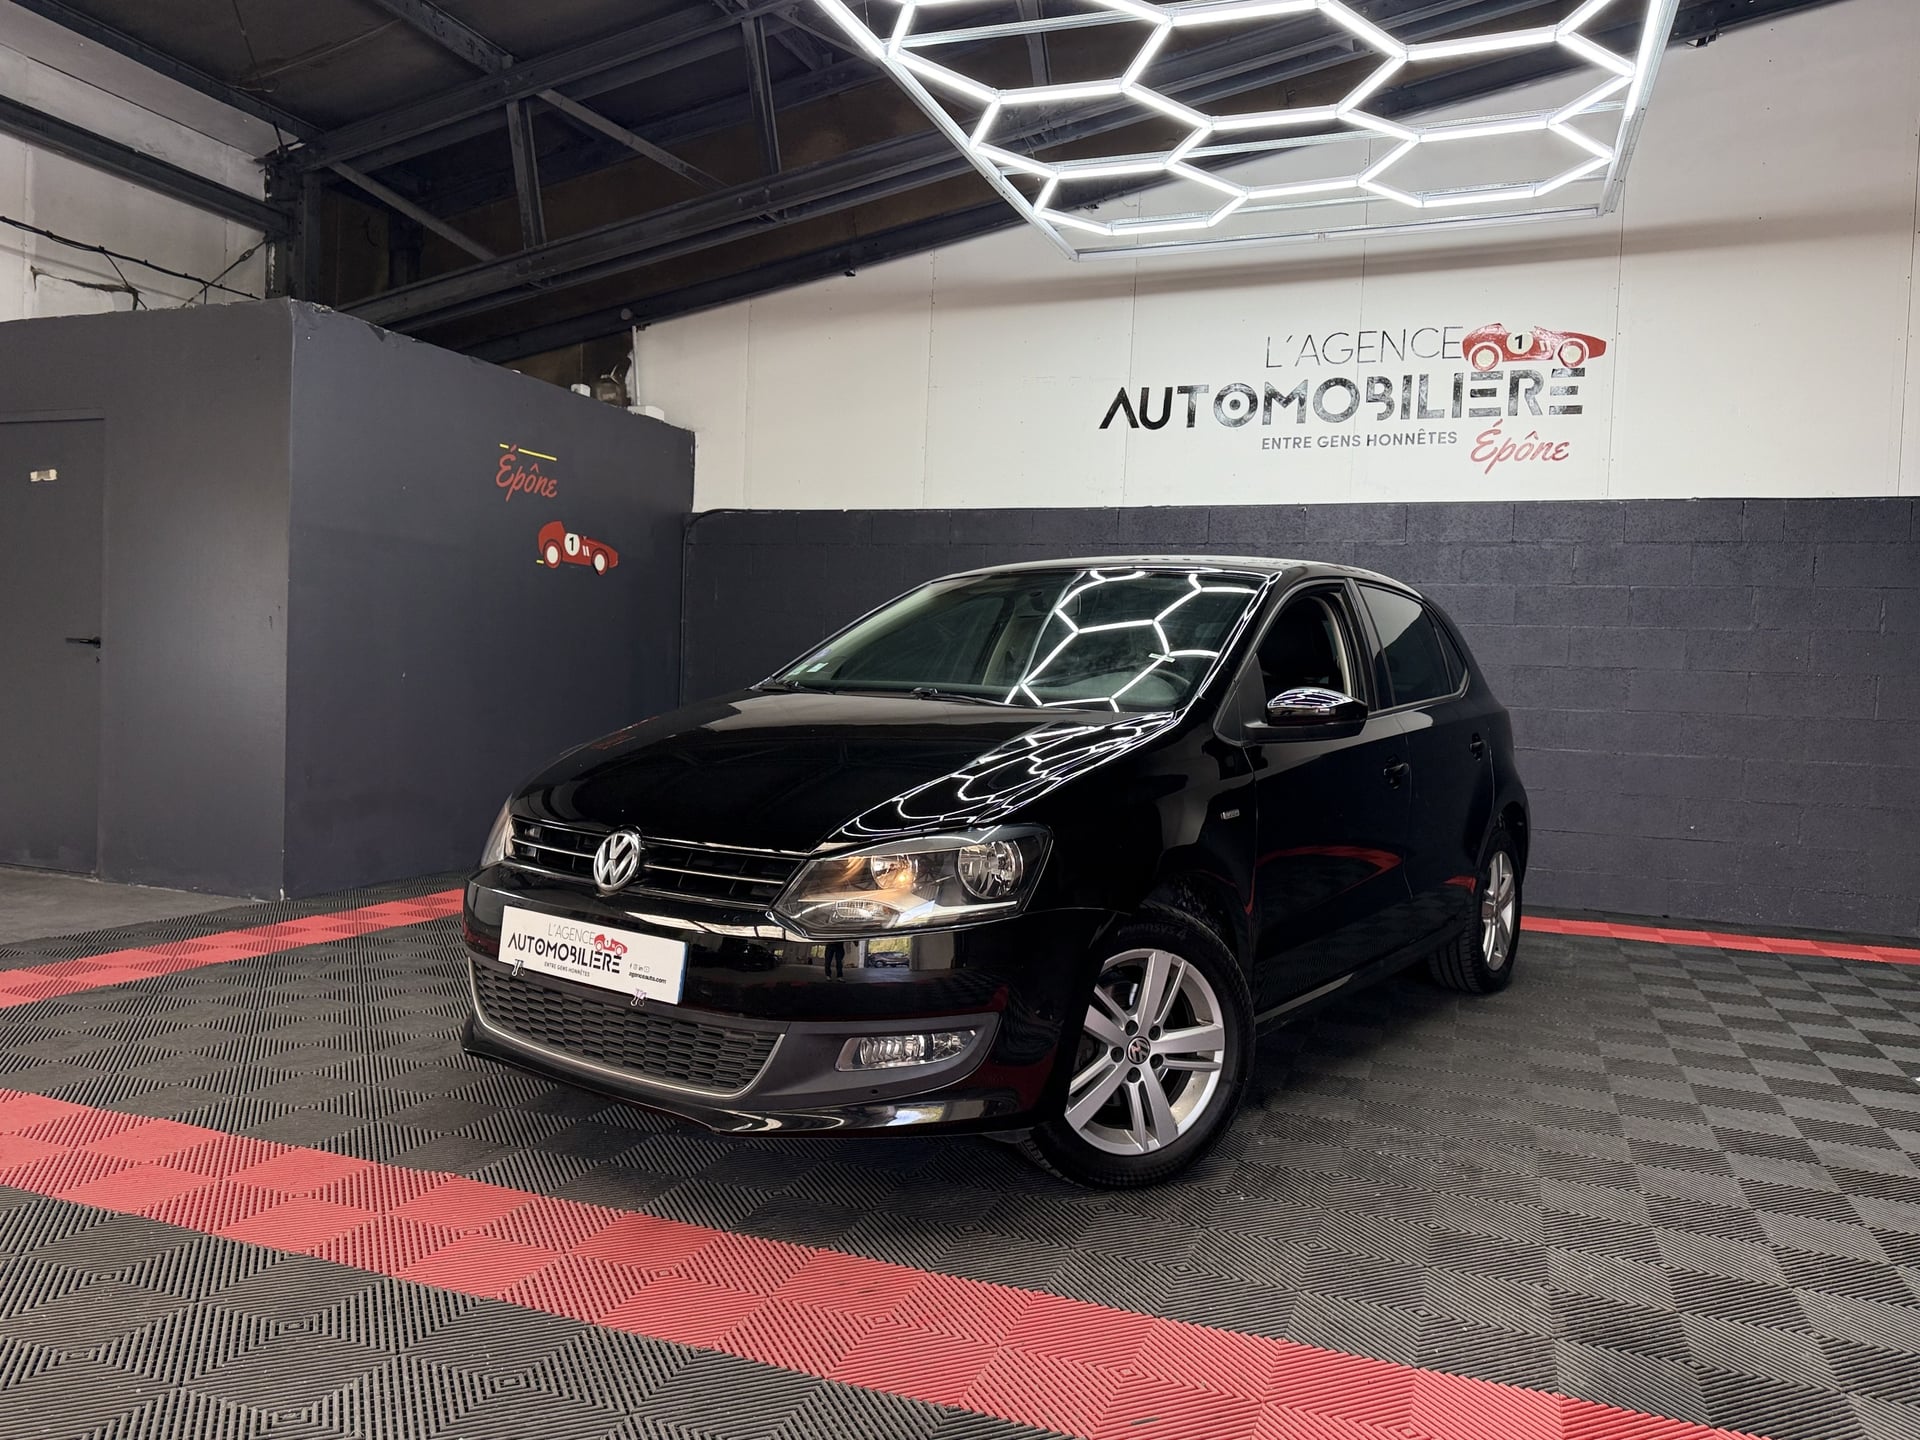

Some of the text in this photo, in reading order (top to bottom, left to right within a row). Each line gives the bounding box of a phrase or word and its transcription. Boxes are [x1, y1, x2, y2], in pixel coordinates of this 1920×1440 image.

[1265, 325, 1464, 369] L'AGENCE
[1261, 428, 1458, 450] ENTRE GENS HONNÊTES
[1470, 418, 1570, 475] Épône
[495, 444, 558, 502] Épône
[568, 536, 575, 552] 1
[547, 923, 596, 946] L'AGENCE
